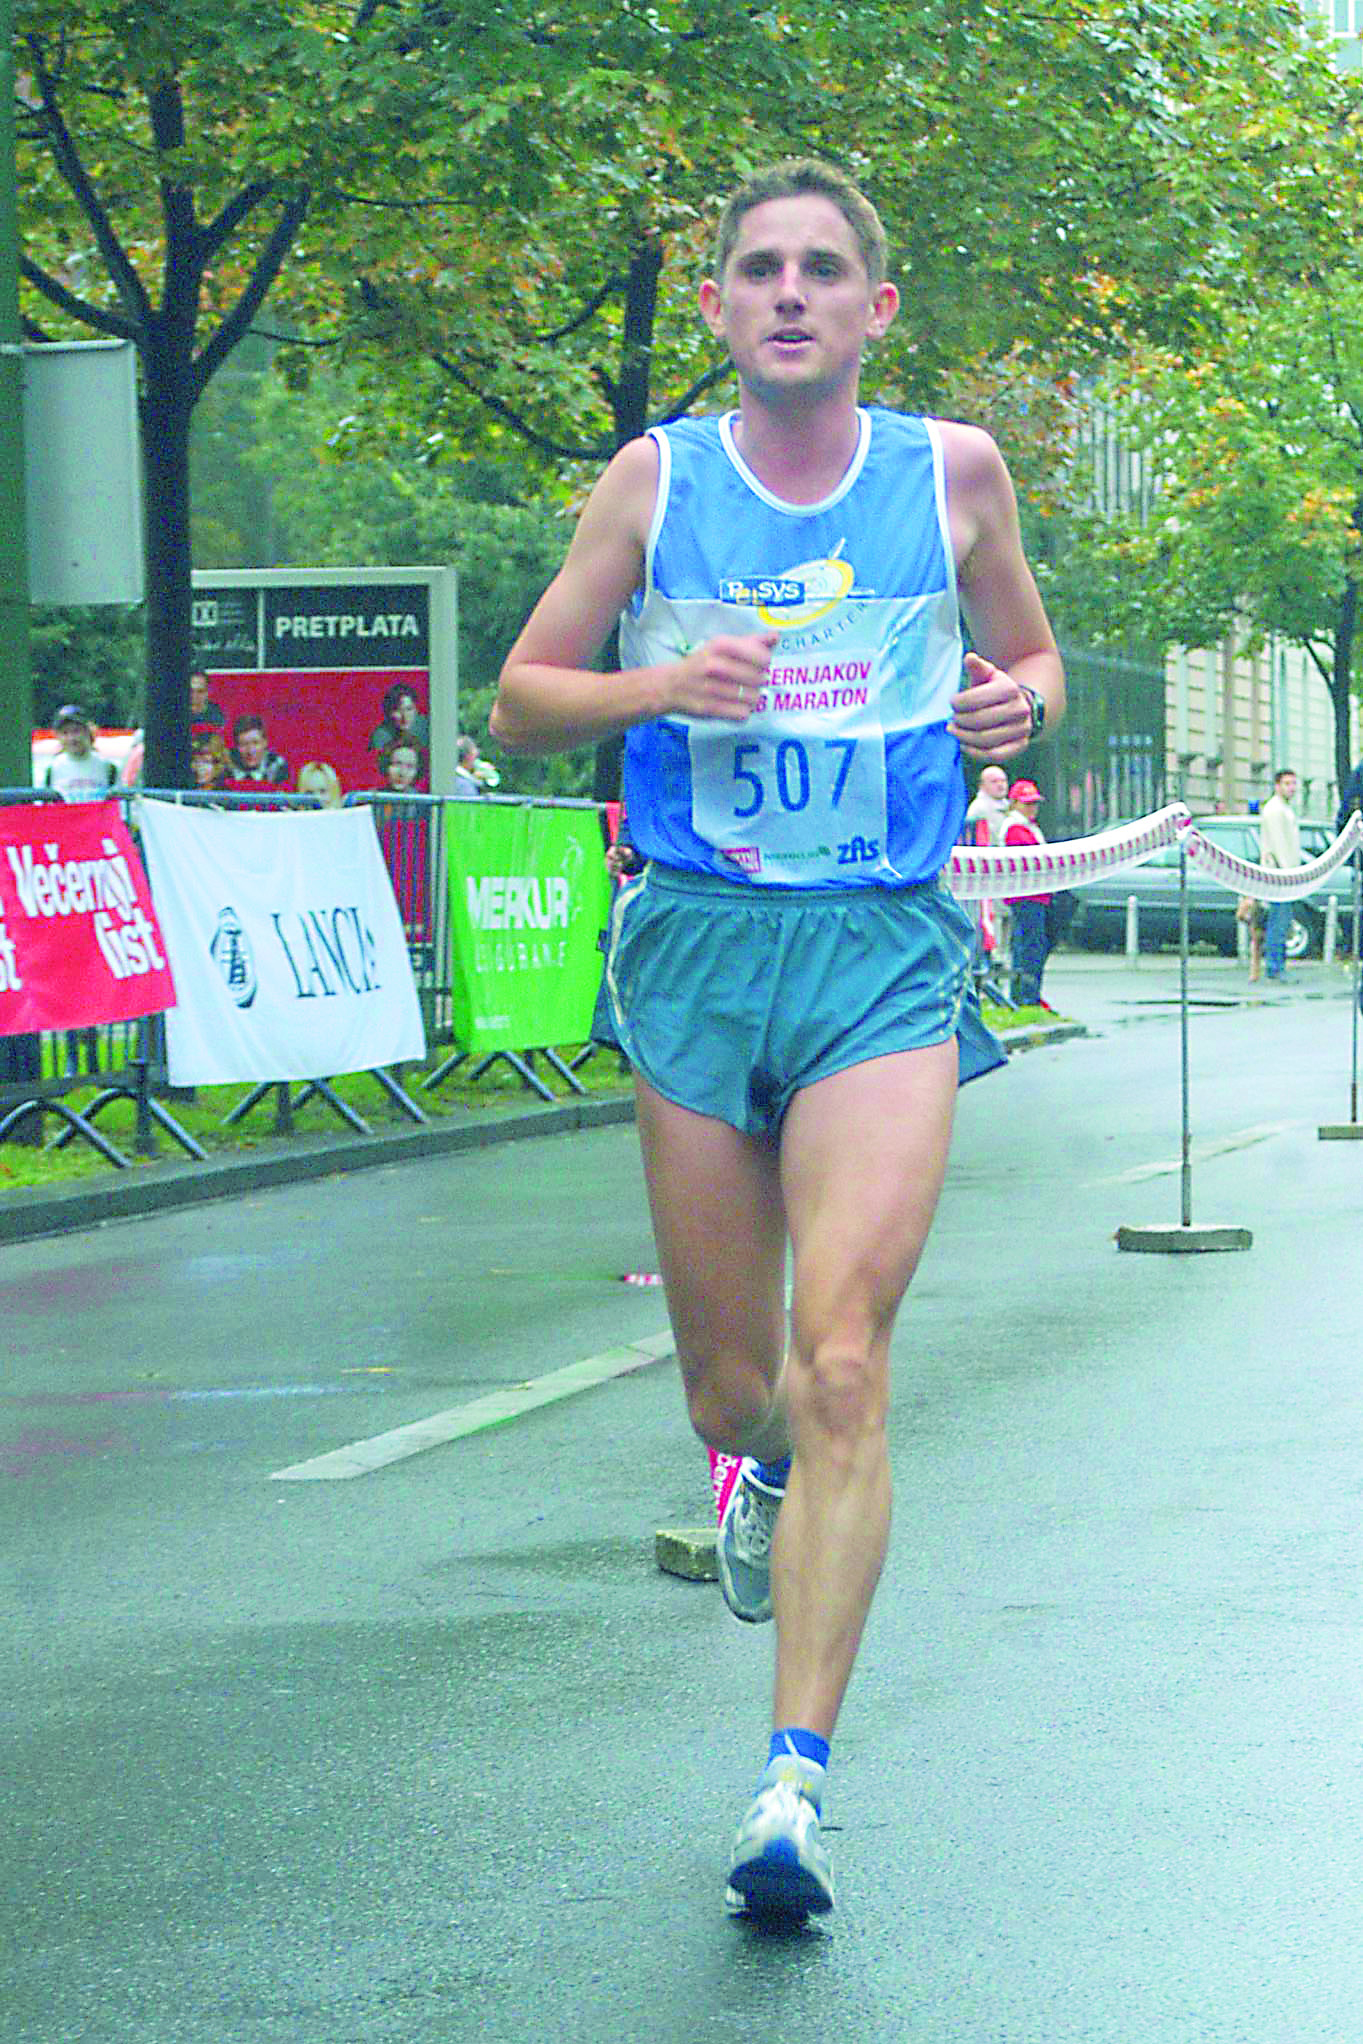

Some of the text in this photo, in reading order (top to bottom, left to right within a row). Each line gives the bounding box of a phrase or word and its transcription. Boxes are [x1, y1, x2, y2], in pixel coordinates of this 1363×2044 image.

[275, 615, 419, 638] PRETPLATA
[766, 661, 871, 686] ERNJAKOV
[773, 688, 867, 711] MARATON
[734, 738, 858, 818] 507
[466, 876, 569, 929] MERKUR
[94, 907, 165, 980] list
